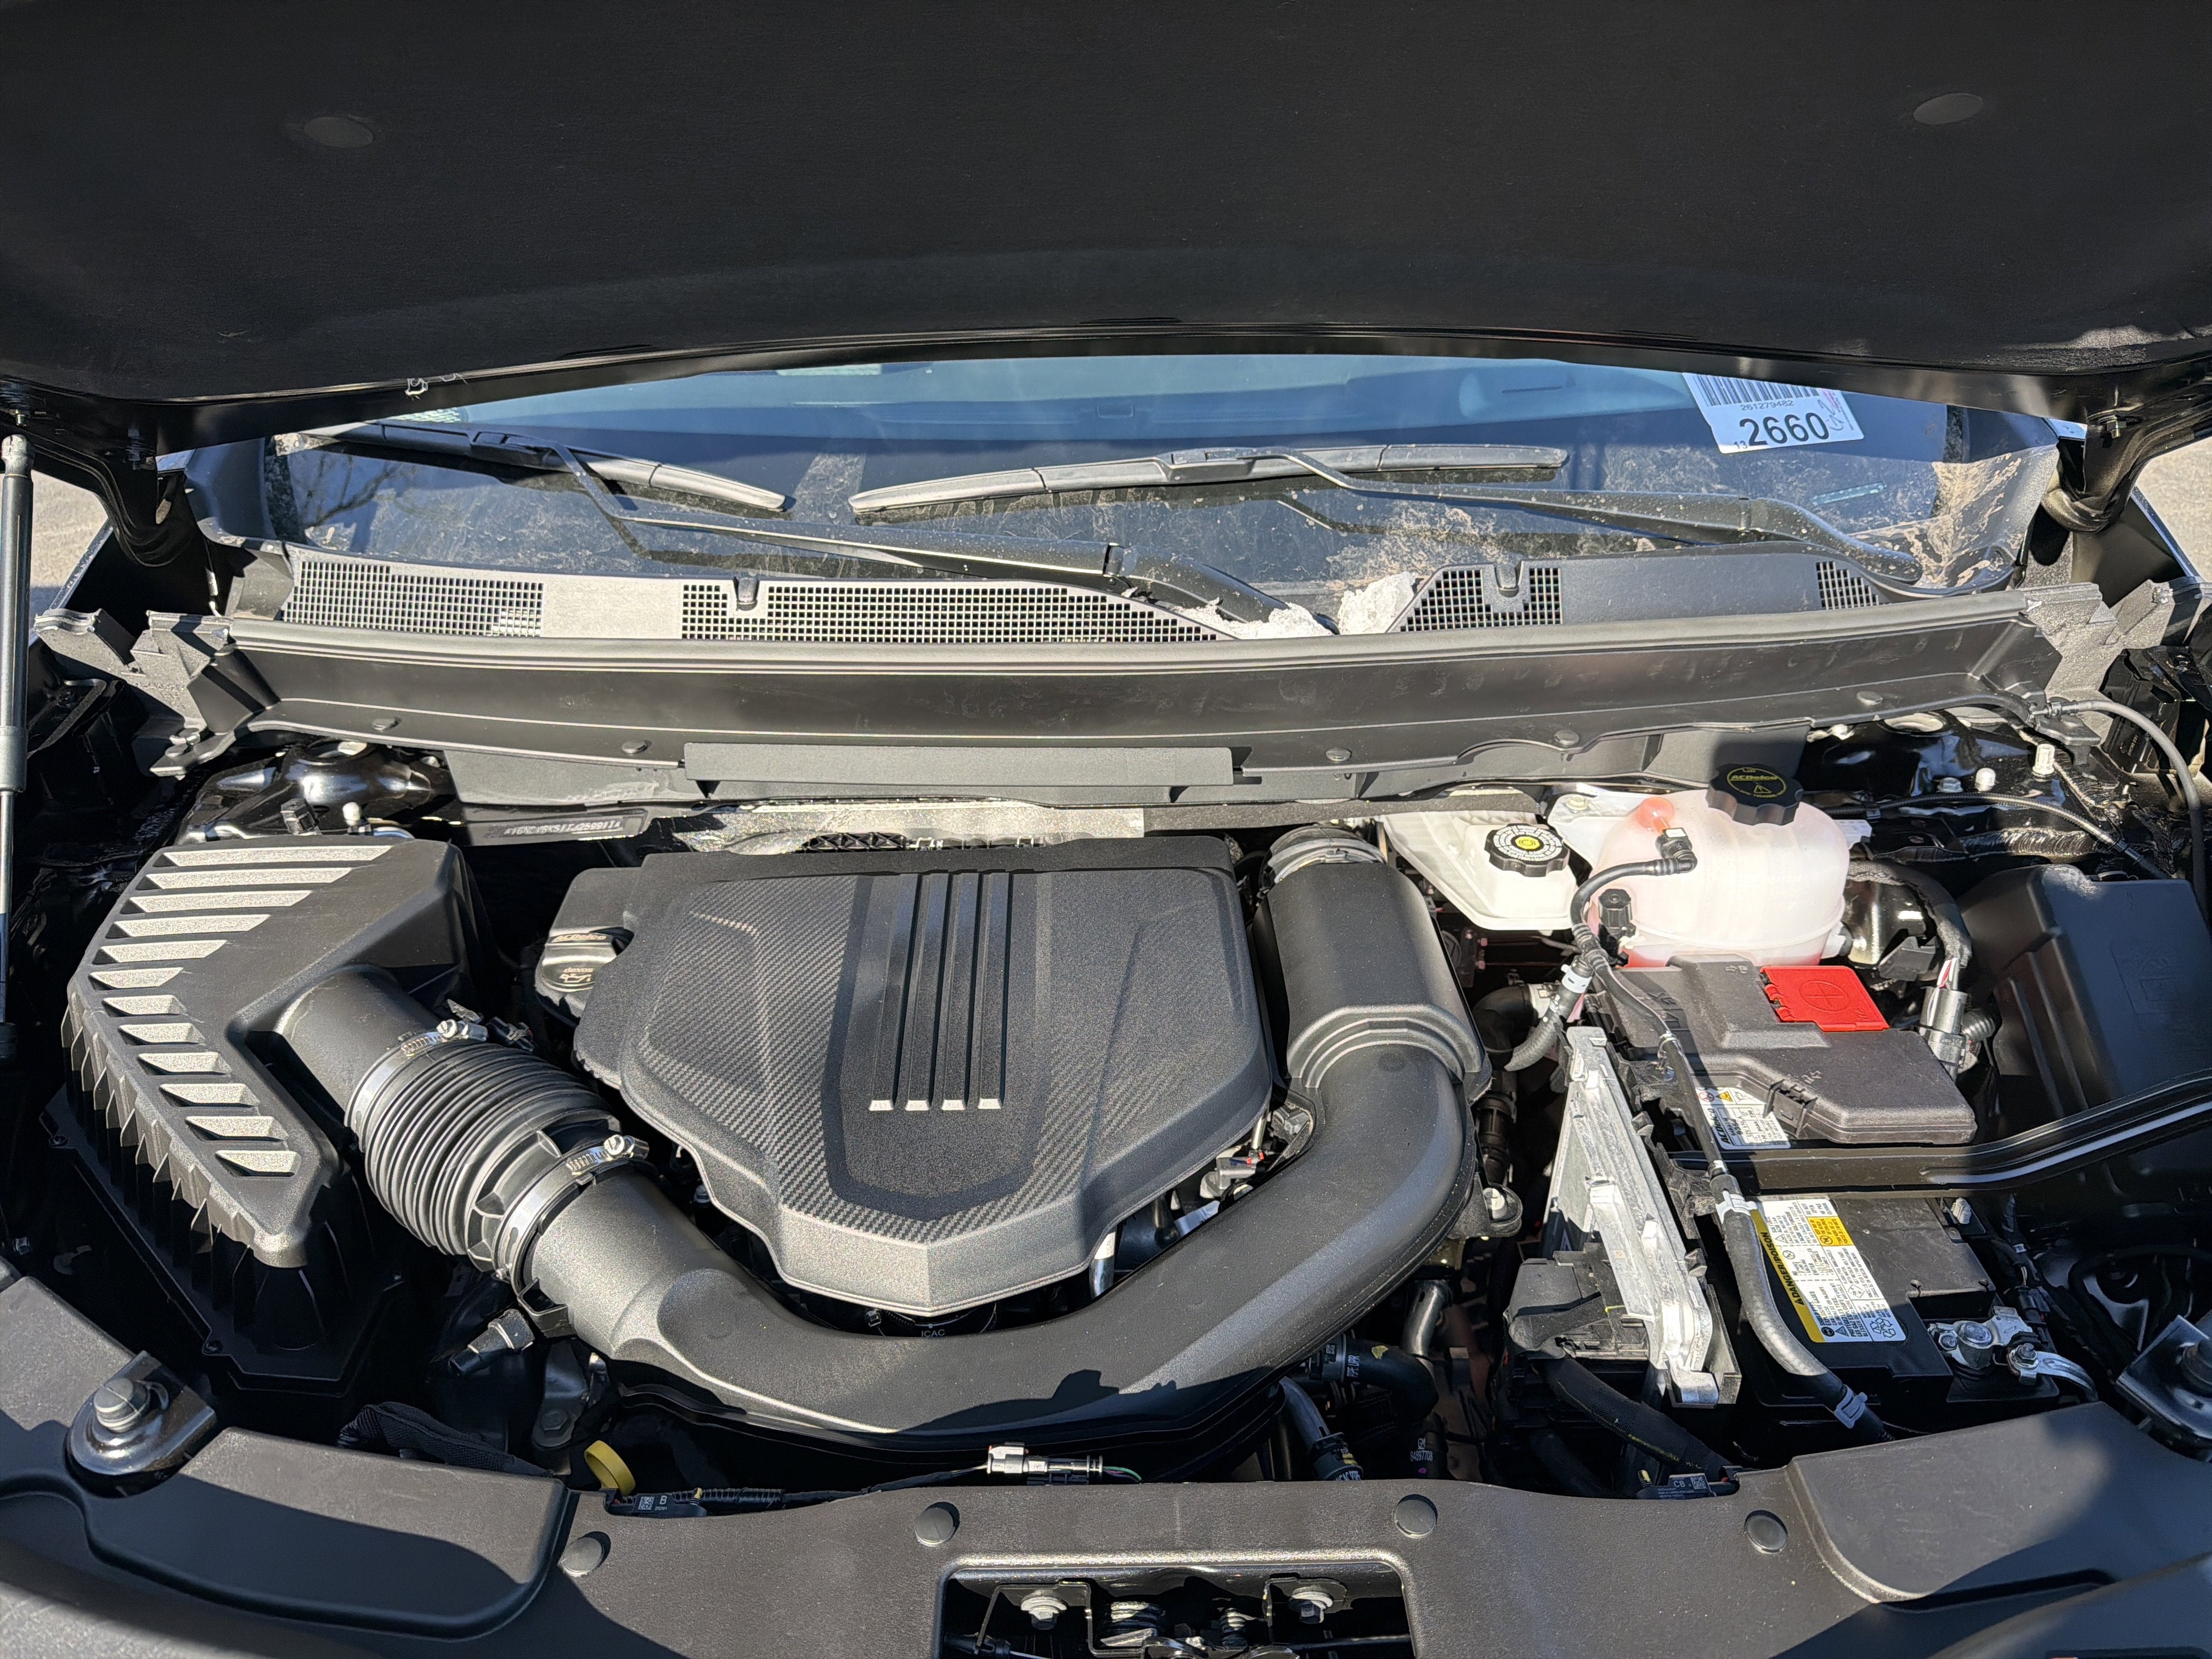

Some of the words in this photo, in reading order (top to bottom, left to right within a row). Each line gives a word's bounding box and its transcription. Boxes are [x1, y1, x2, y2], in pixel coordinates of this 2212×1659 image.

[1740, 400, 1794, 410] 261279482
[1739, 412, 1830, 446] 2660
[1734, 440, 1748, 449] 13
[551, 934, 607, 943] ACDelco
[1707, 1107, 1731, 1145] ACDelco
[1760, 1231, 1801, 1298] DANGER/POISON
[1841, 1316, 1857, 1337] PROTÉGEZ
[1849, 1321, 1859, 1329] GAZ
[1855, 1320, 1869, 1336] BLESSER
[1348, 1355, 1361, 1367] UPR
[659, 1496, 667, 1504] B
